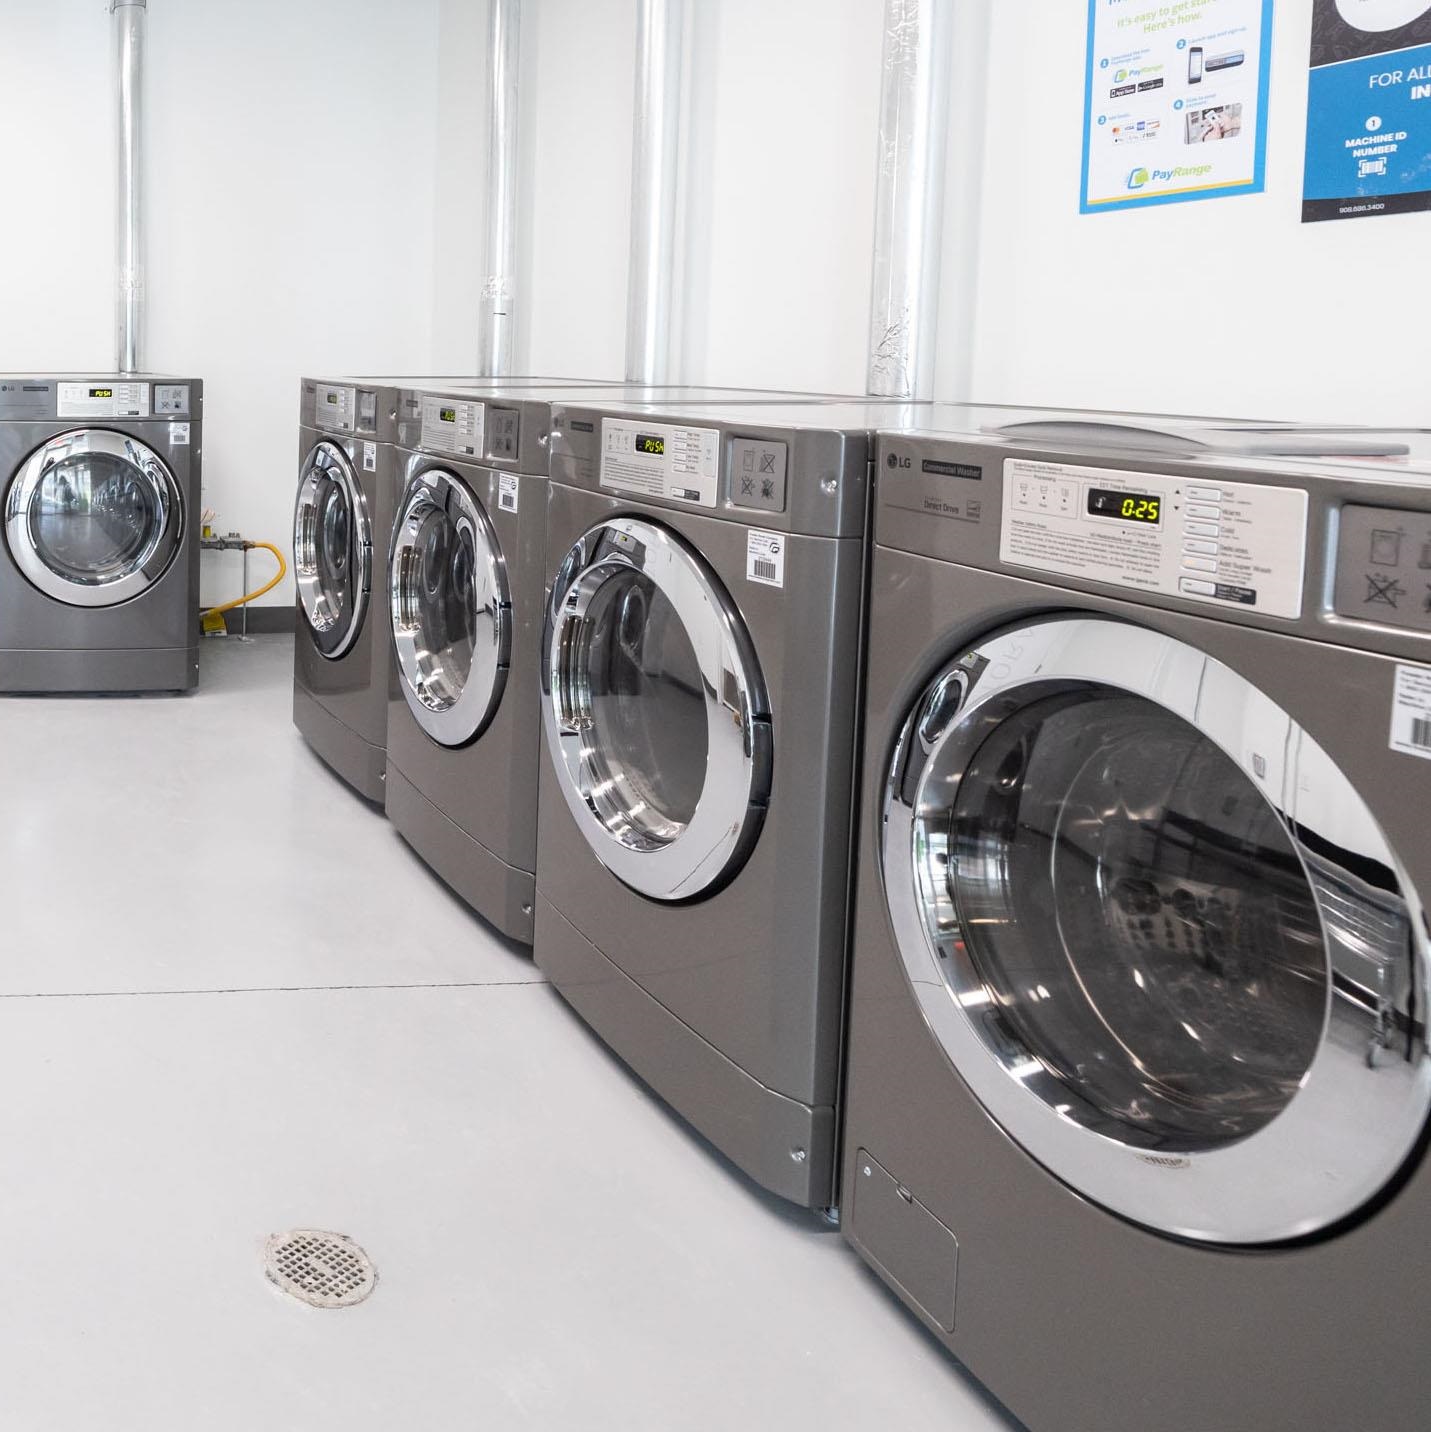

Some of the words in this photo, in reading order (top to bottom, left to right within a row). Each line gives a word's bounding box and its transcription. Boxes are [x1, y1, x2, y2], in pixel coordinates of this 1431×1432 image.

[1159, 7, 1168, 16] to
[1369, 70, 1404, 88] FOR
[1345, 133, 1394, 148] MACHINE
[1395, 131, 1407, 140] ID
[1352, 144, 1398, 158] NUMBER
[1152, 163, 1213, 181] PayRange
[899, 457, 911, 469] LG
